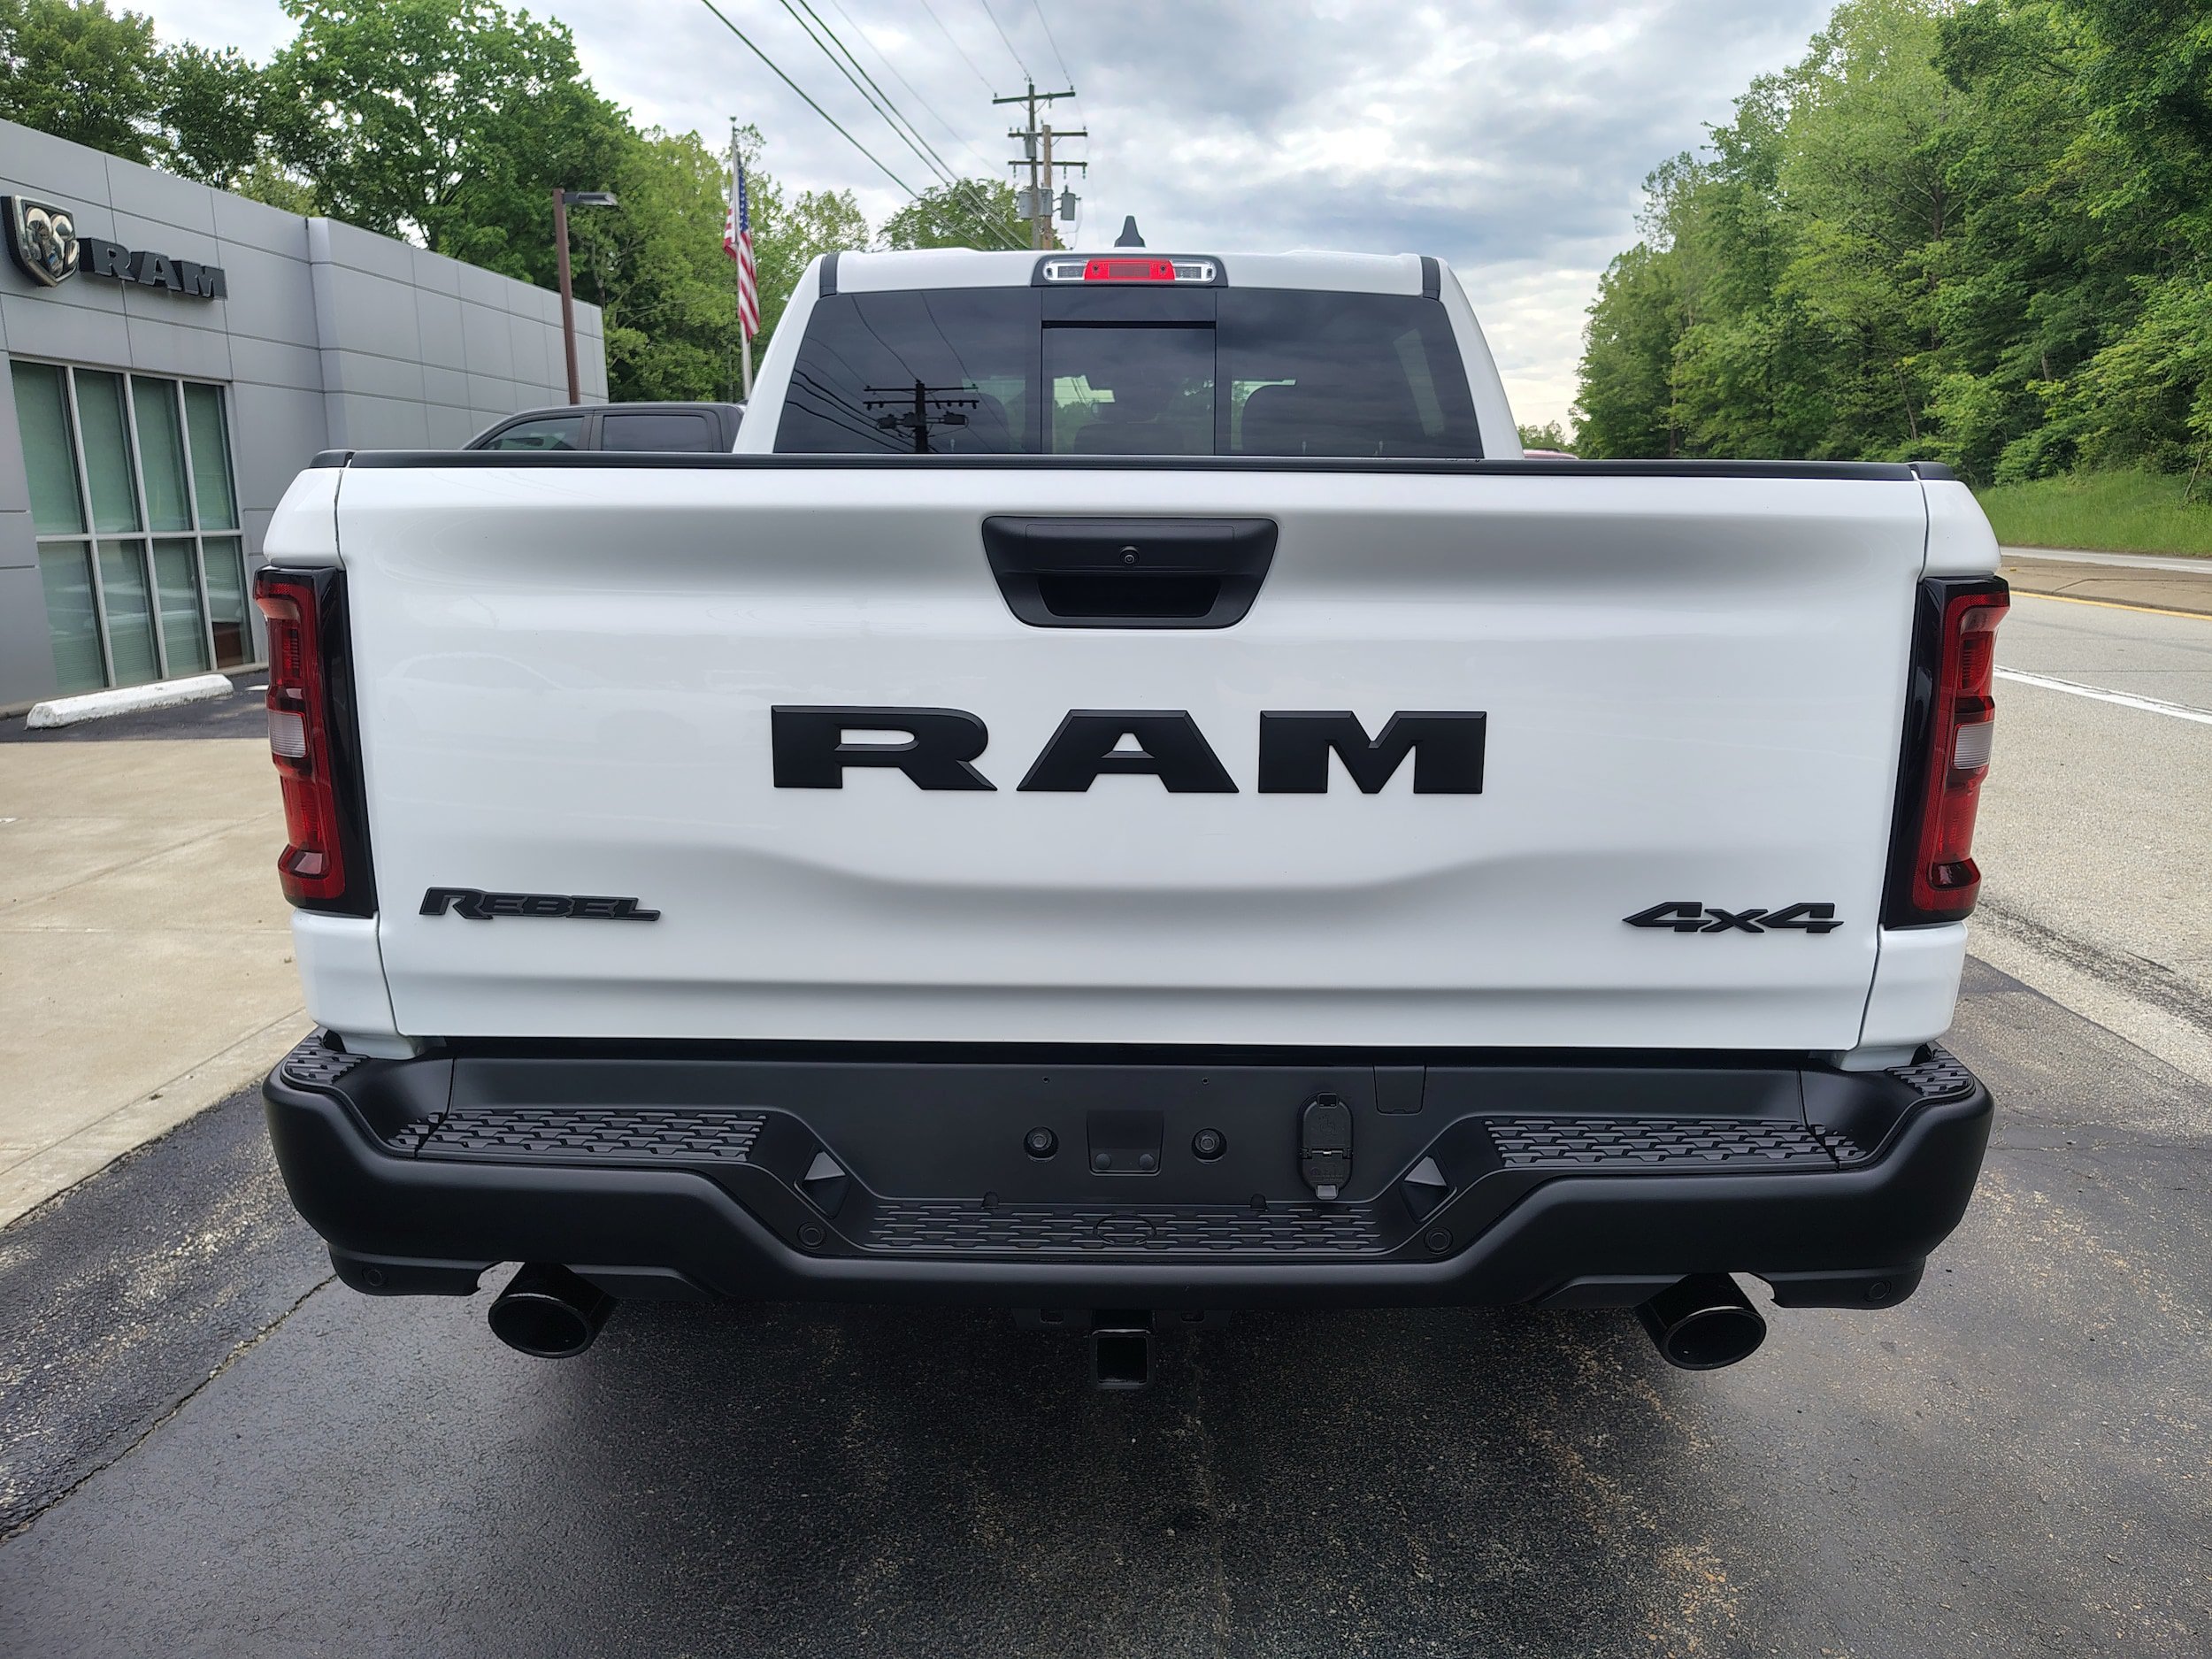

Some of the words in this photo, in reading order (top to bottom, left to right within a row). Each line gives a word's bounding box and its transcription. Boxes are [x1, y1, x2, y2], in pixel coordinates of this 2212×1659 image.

[88, 237, 228, 300] RAM
[771, 704, 1487, 795] RAM
[419, 887, 662, 922] REBEL
[1621, 901, 1845, 934] 4x4
